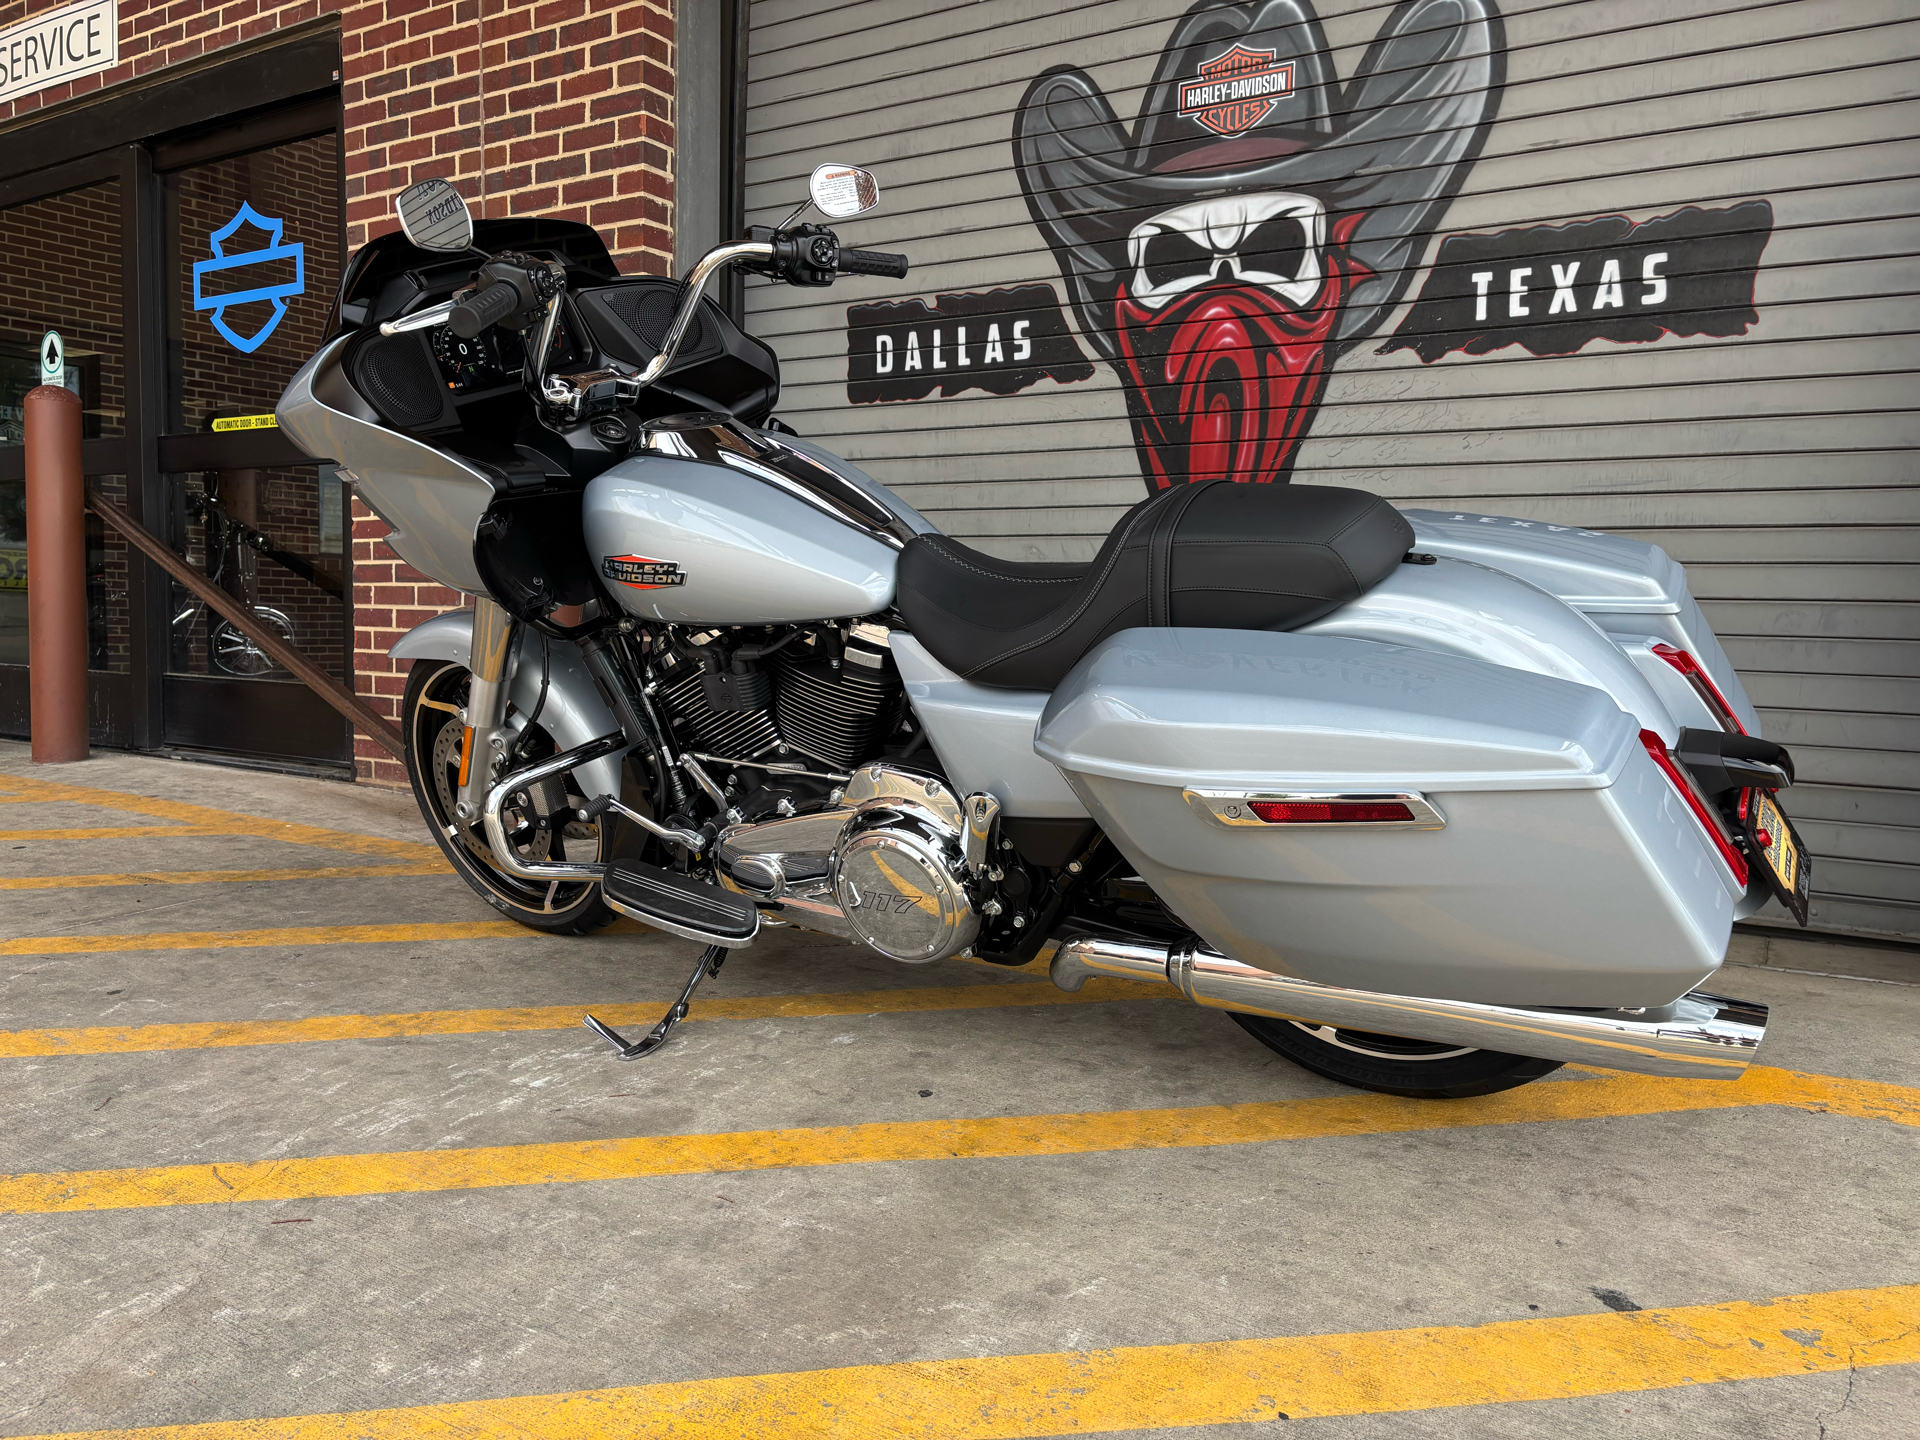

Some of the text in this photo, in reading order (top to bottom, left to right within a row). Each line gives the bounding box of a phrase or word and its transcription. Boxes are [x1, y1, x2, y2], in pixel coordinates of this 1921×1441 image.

[0, 13, 101, 87] SERVICE
[1210, 54, 1263, 79] MOTOR
[1187, 71, 1286, 107] HARLEY-DAVIDSON
[1208, 101, 1261, 130] CYCLES
[1472, 252, 1668, 321] TEXAS
[876, 320, 1031, 374] DALLAS
[216, 419, 239, 430] AUTOMATIC
[240, 418, 252, 429] DOOR
[255, 417, 269, 427] STAND
[605, 560, 675, 573] HARLEY-
[862, 891, 923, 914] 117
